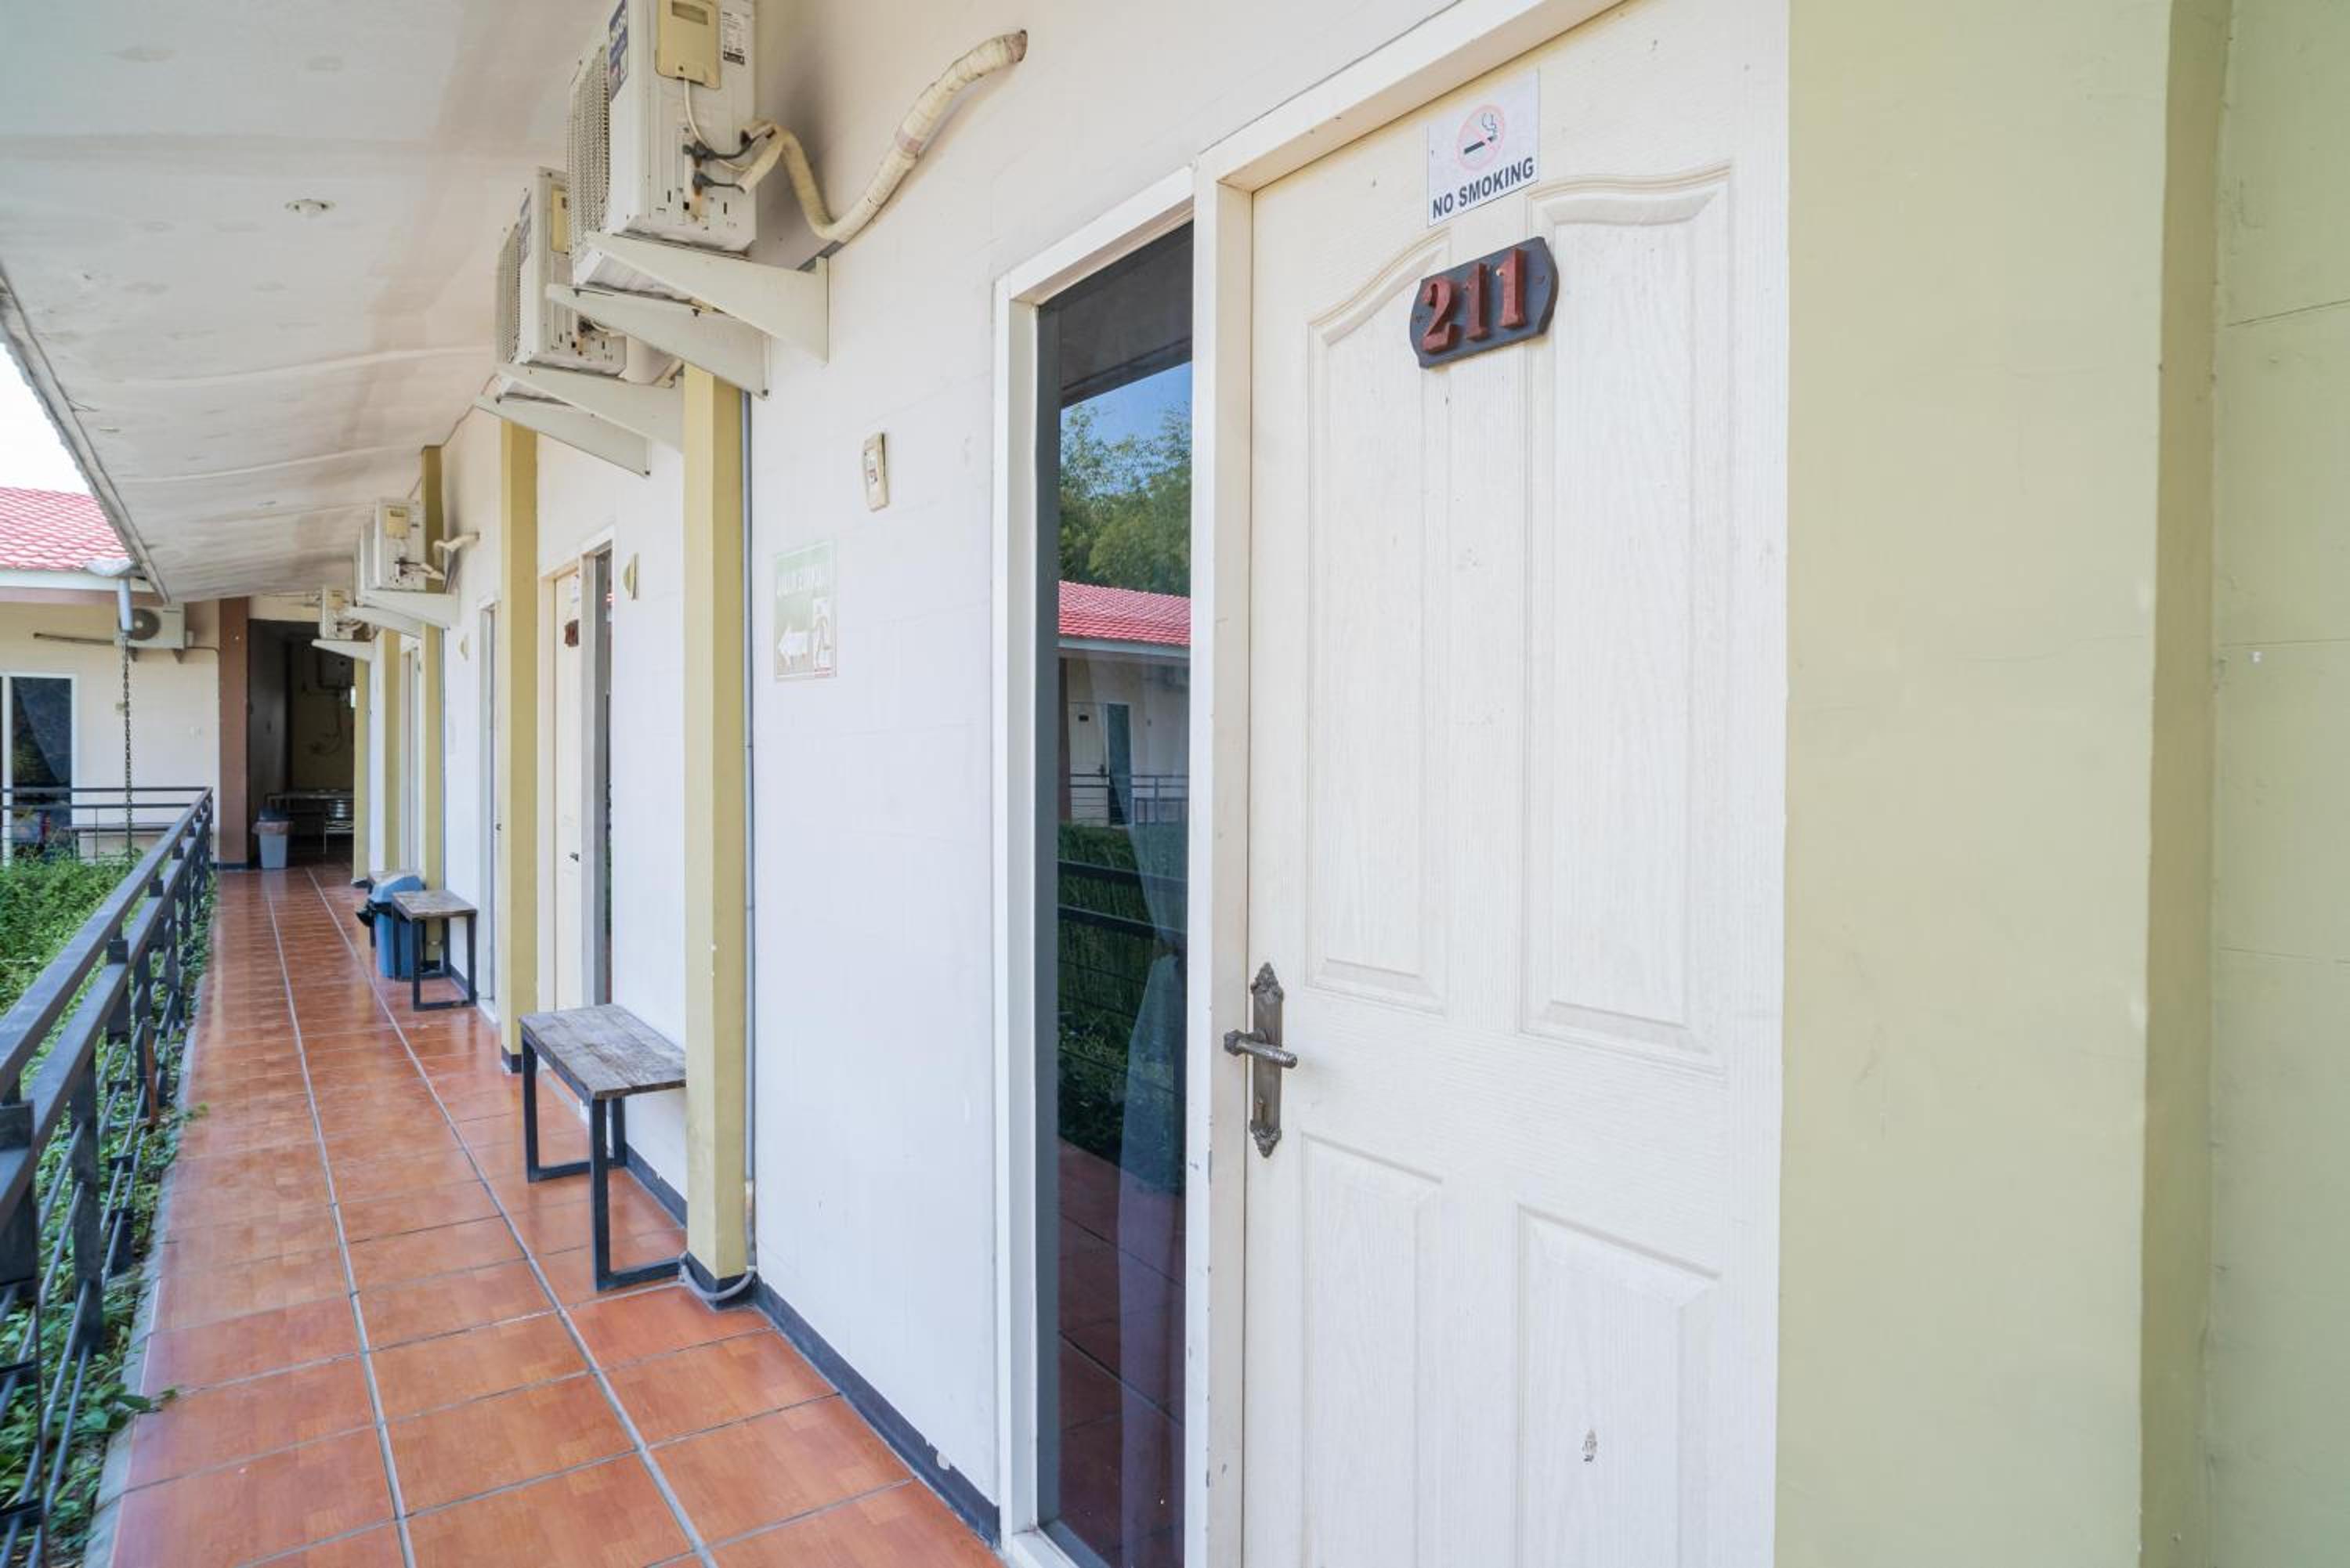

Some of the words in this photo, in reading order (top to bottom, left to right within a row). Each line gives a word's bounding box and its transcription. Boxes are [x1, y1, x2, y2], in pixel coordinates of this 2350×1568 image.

[1433, 193, 1454, 219] NO
[1459, 156, 1535, 208] SMOKING
[1422, 247, 1527, 353] 211
